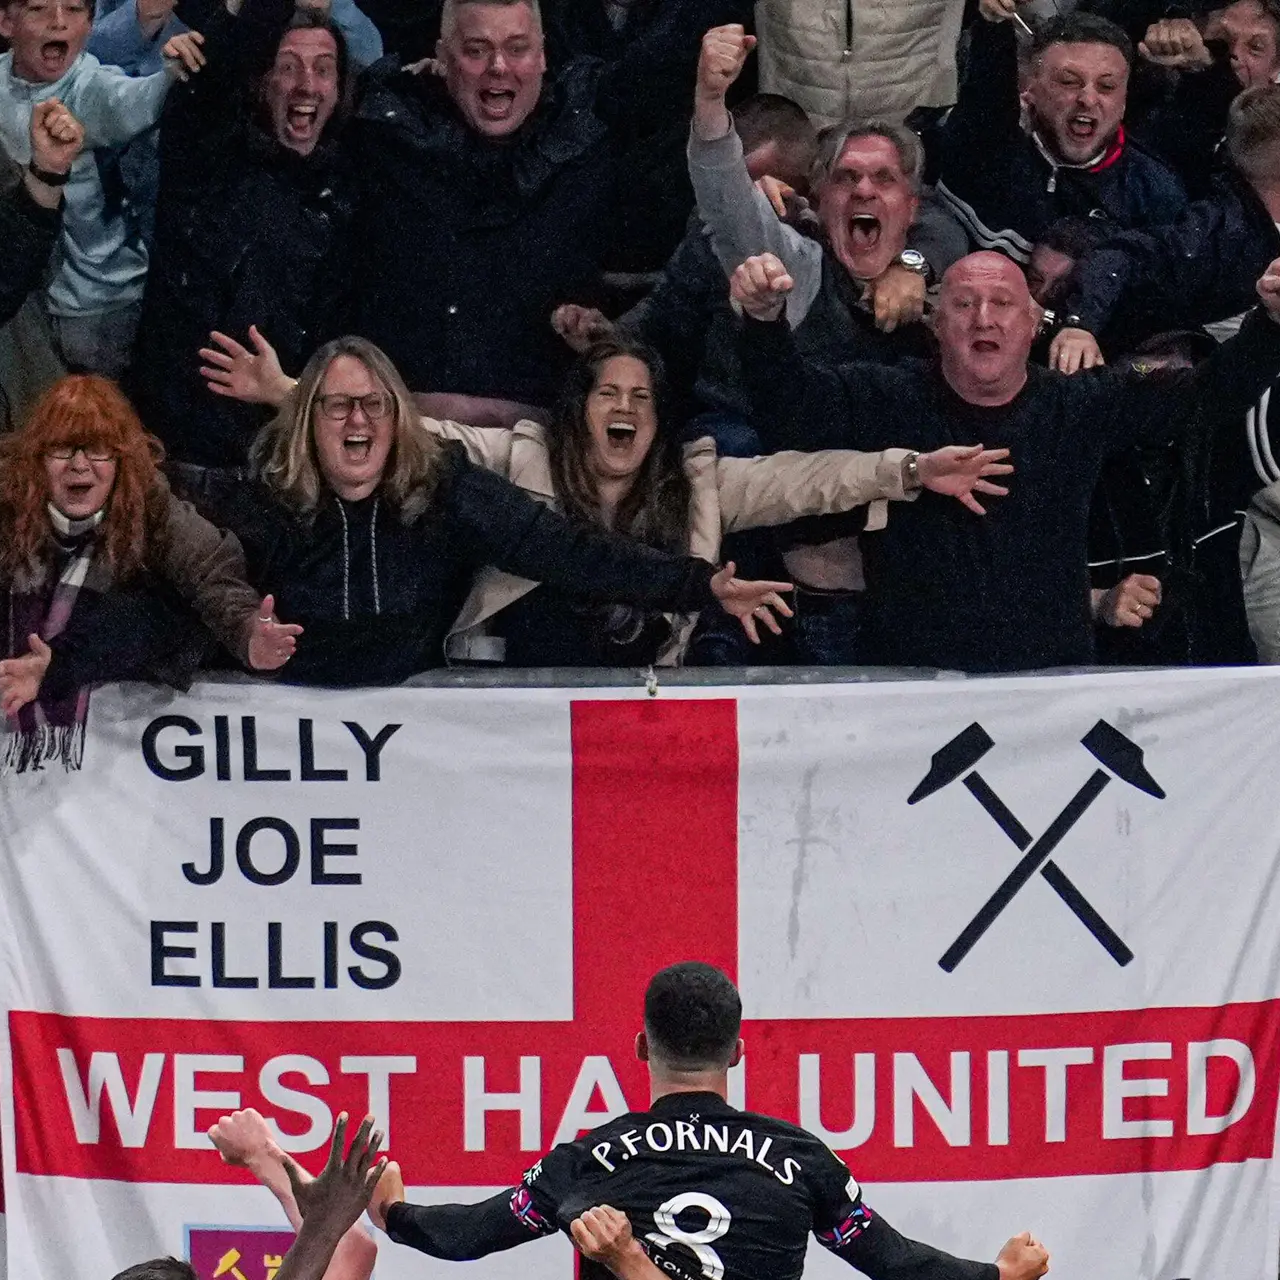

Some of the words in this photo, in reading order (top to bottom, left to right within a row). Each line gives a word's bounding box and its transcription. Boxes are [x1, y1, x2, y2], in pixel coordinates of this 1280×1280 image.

[141, 714, 404, 783] GILLY
[182, 816, 363, 887] JOE
[150, 920, 402, 991] ELLIS
[55, 1048, 417, 1153] WEST
[461, 1053, 747, 1153] HA
[798, 1037, 1258, 1154] UNITED
[591, 1119, 802, 1186] P.FORNALS
